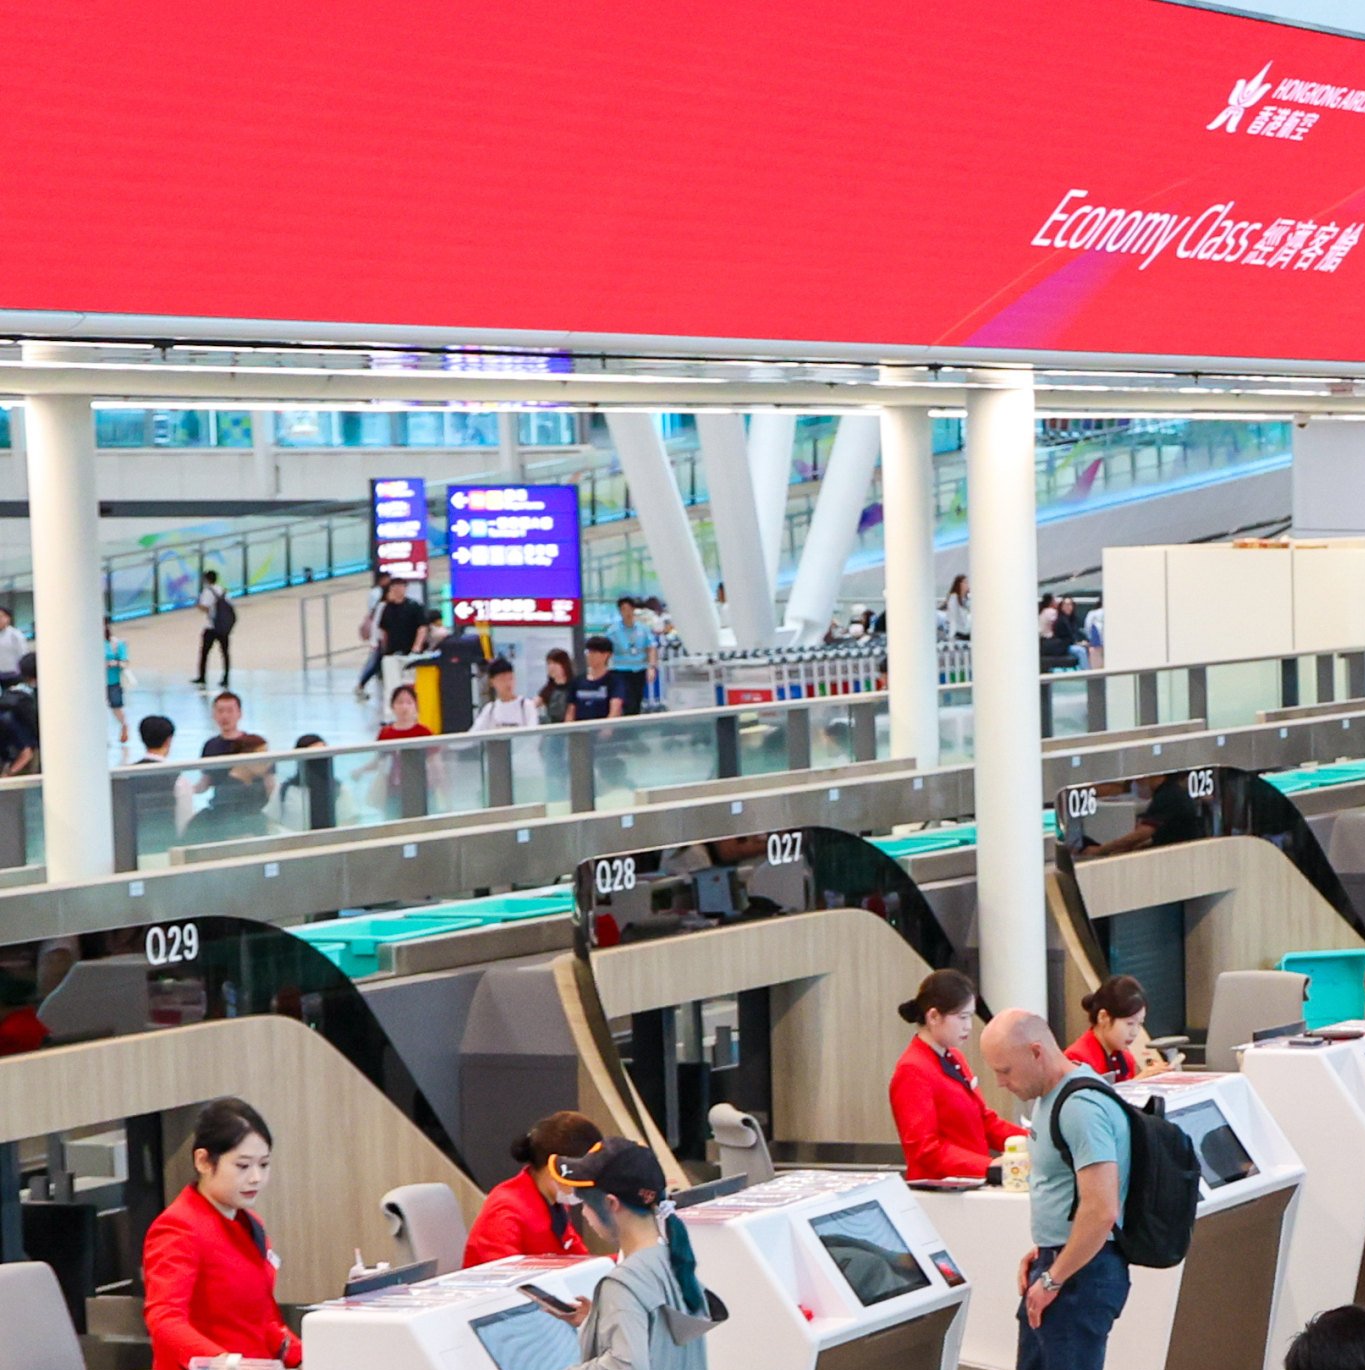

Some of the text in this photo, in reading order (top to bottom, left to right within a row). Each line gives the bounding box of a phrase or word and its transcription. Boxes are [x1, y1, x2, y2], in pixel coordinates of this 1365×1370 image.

[1272, 77, 1347, 109] HONGKONG
[1247, 105, 1320, 141] 香港航空
[1030, 188, 1191, 271] Economy
[1176, 200, 1262, 263] Class
[1187, 769, 1214, 800] Q25
[1068, 787, 1098, 819] Q26
[766, 831, 802, 867] Q27
[595, 856, 636, 895] Q28
[145, 923, 200, 966] Q29
